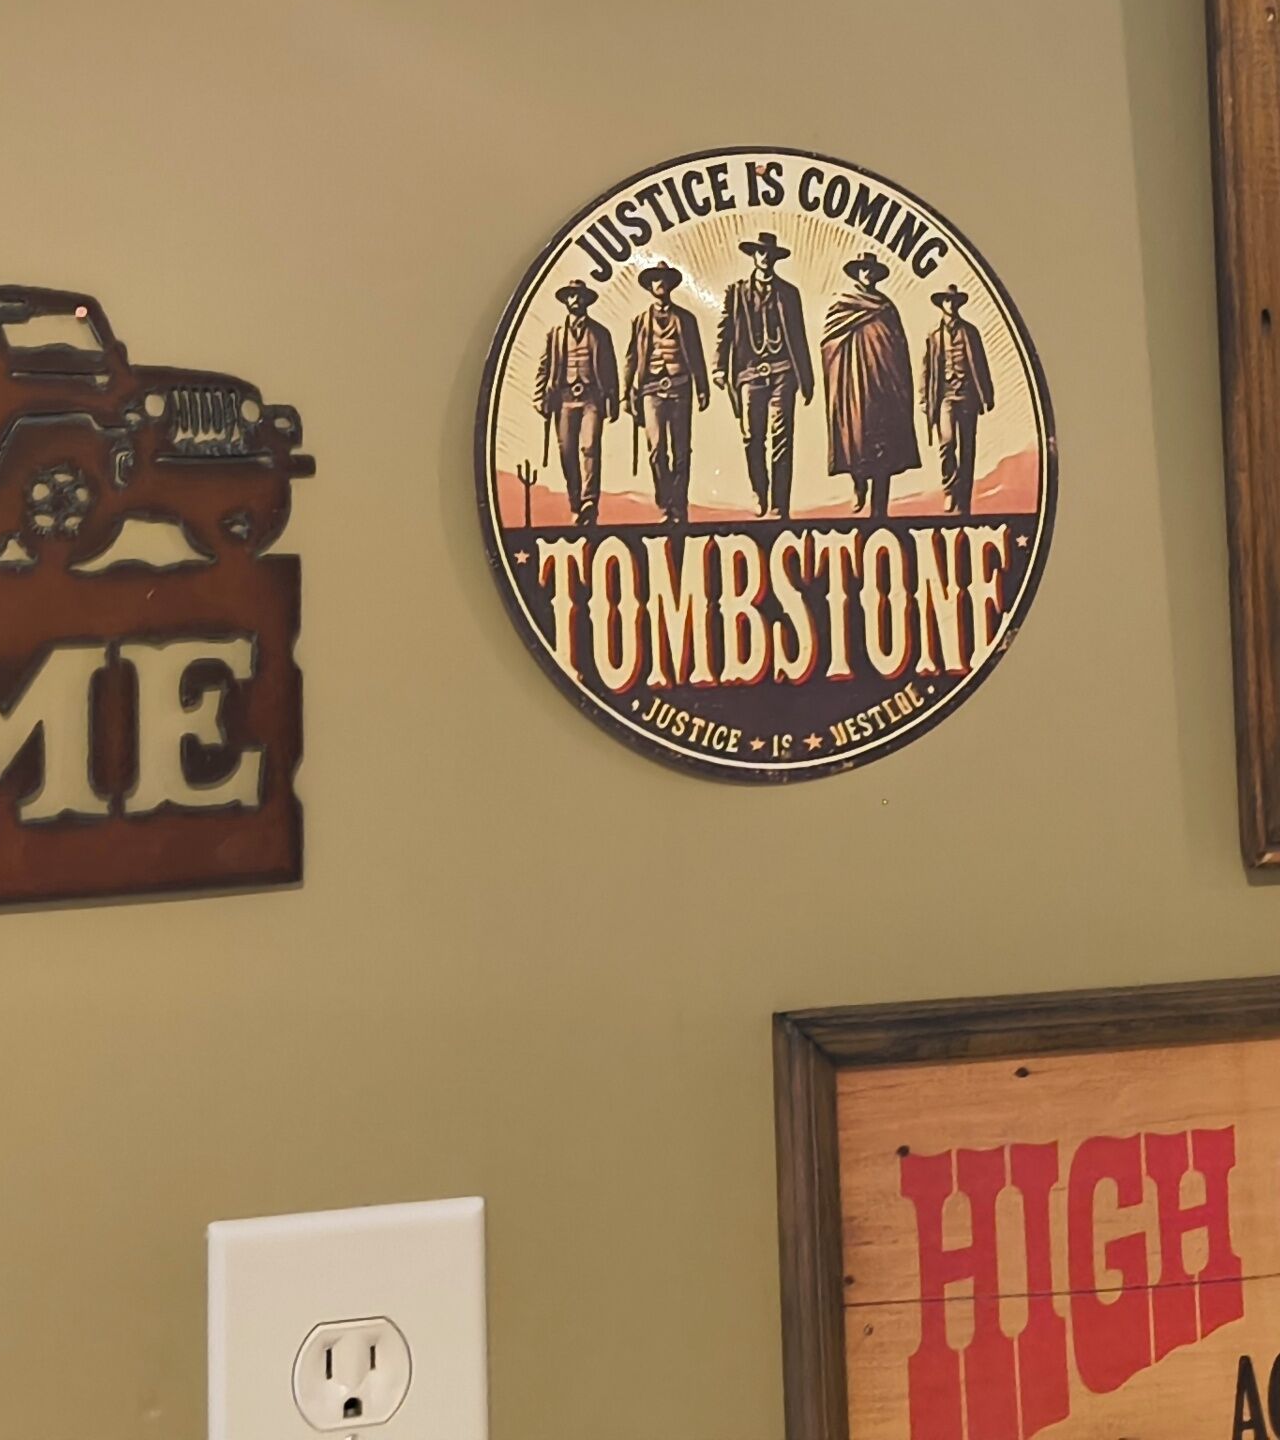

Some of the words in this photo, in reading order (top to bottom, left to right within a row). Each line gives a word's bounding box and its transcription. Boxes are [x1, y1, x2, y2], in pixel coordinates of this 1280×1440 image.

[574, 162, 733, 283] JUSTICE
[747, 161, 784, 207] IS
[798, 167, 949, 278] COMING
[536, 524, 1014, 692] TOMBSTONE
[642, 698, 742, 753] JUSTICE
[771, 734, 793, 758] IS
[899, 1123, 1245, 1440] HIGH
